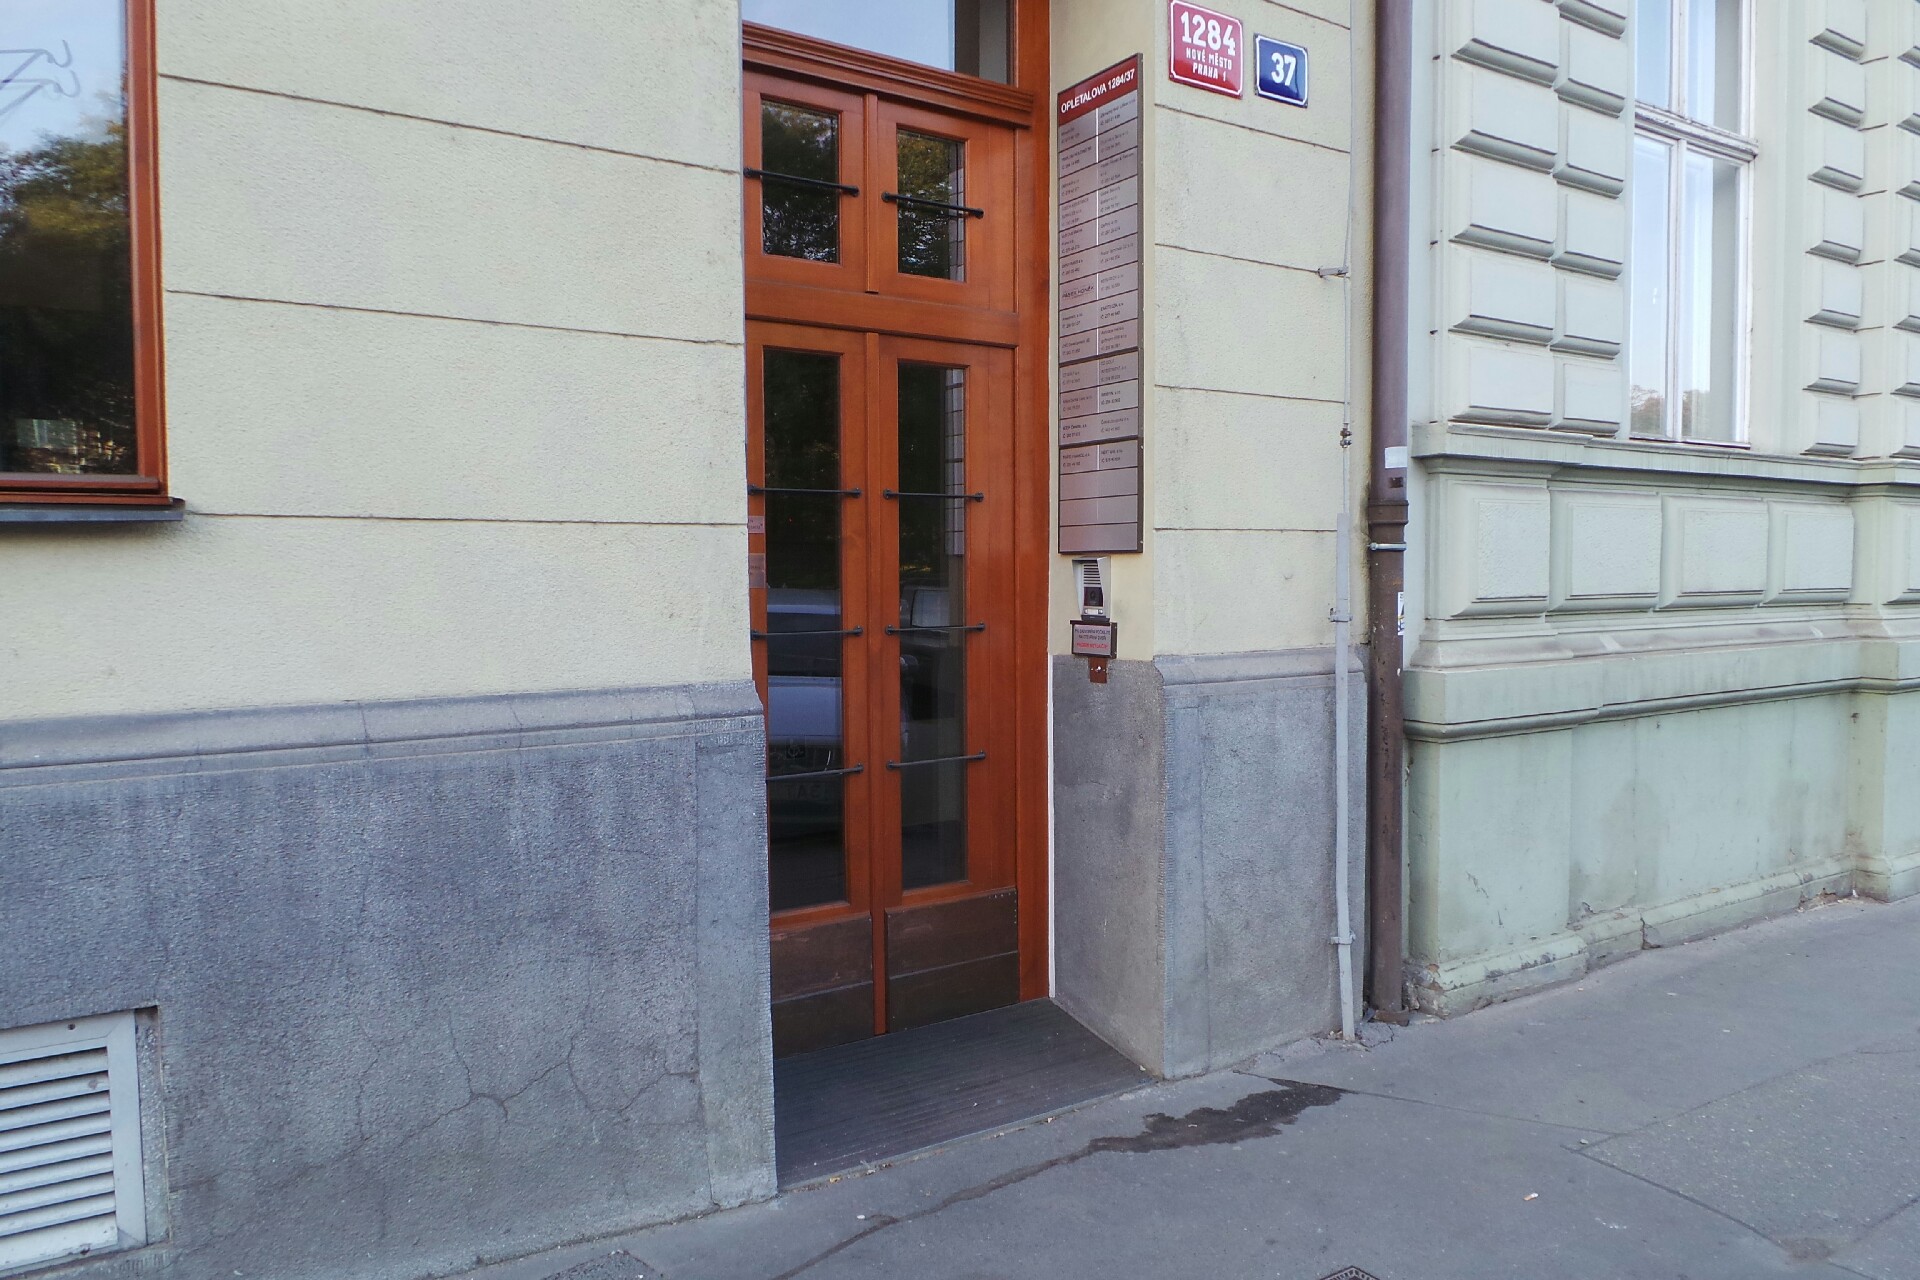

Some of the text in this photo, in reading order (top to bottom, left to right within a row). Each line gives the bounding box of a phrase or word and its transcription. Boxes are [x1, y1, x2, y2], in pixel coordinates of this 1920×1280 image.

[1181, 13, 1236, 56] 1284
[1186, 47, 1233, 71] NOVÉ MĚSTO
[1192, 63, 1228, 82] PRAHA 1
[1271, 52, 1296, 86] 37
[1061, 83, 1107, 113] OPLETALOVA
[1108, 69, 1135, 90] 1284/37
